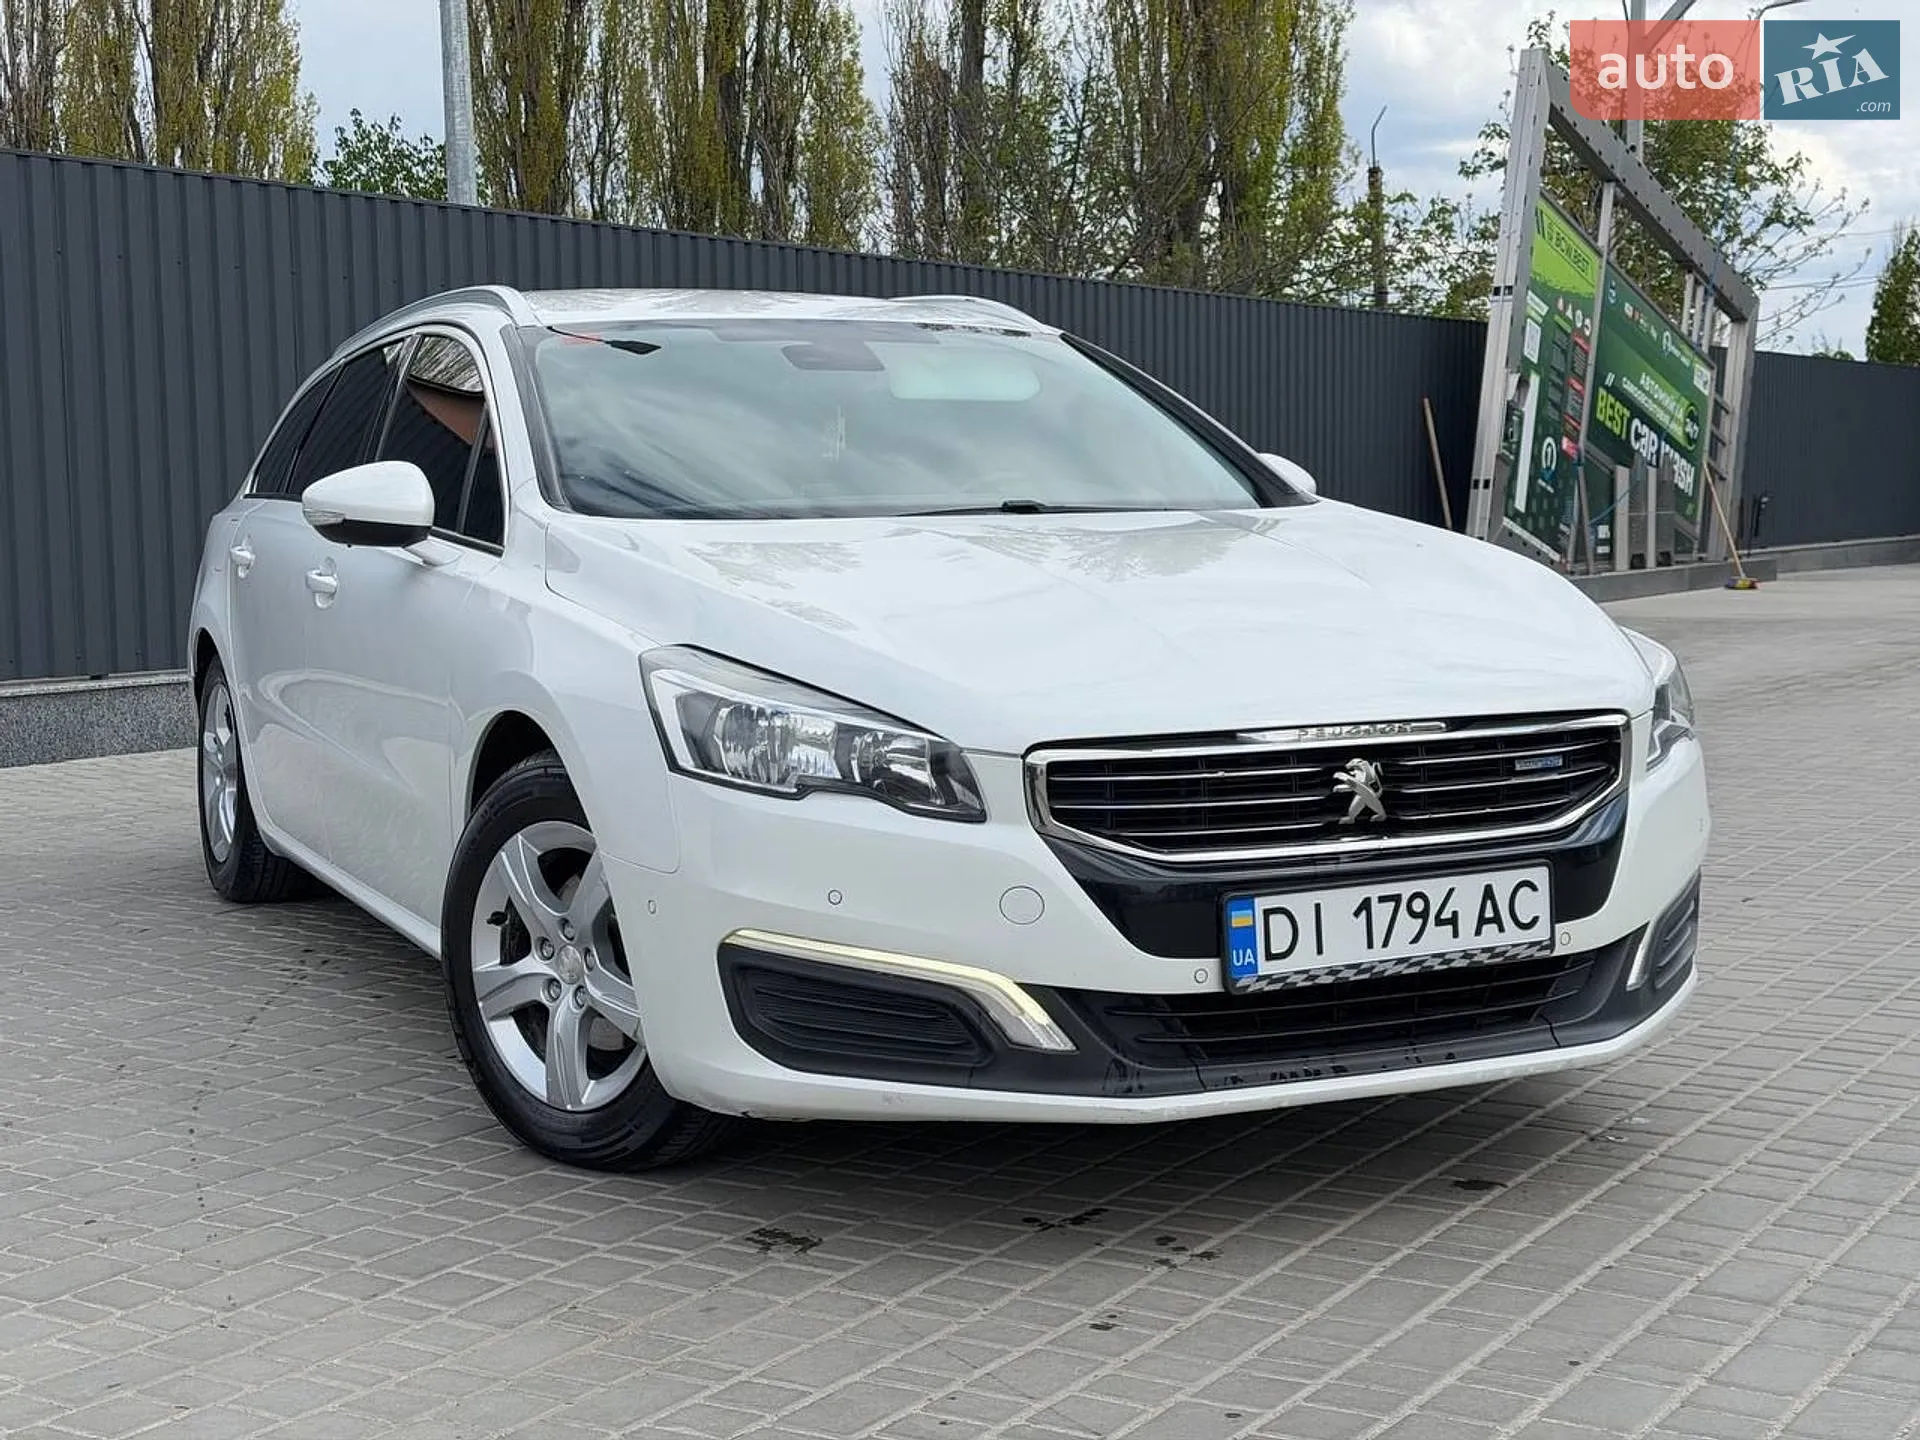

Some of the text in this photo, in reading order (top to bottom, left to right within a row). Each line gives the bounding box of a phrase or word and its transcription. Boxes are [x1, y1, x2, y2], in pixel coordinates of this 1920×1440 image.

[1597, 387, 1630, 440] BEST
[1263, 879, 1540, 961] DI 1794 AC
[1233, 948, 1256, 966] UA
